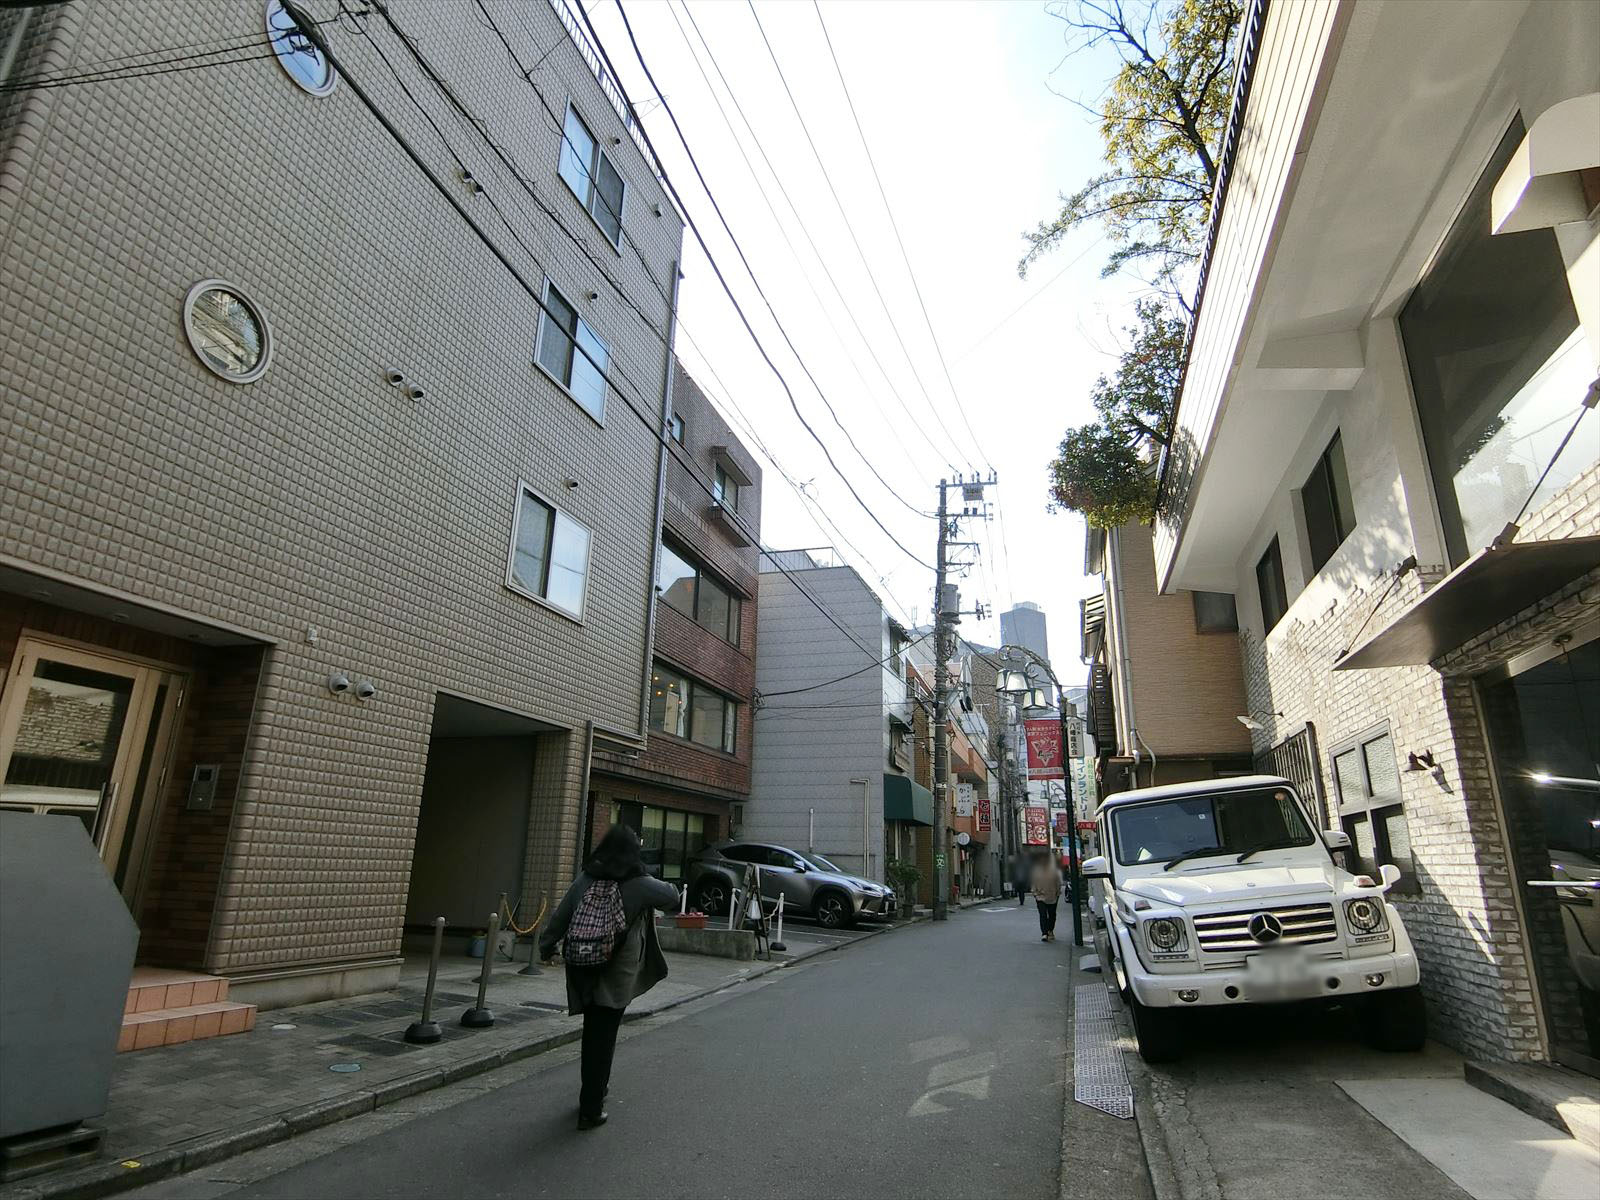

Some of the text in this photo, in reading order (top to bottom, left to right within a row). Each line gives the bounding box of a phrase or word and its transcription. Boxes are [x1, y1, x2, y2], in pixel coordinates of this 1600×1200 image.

[1077, 757, 1088, 820] コインランドリー
